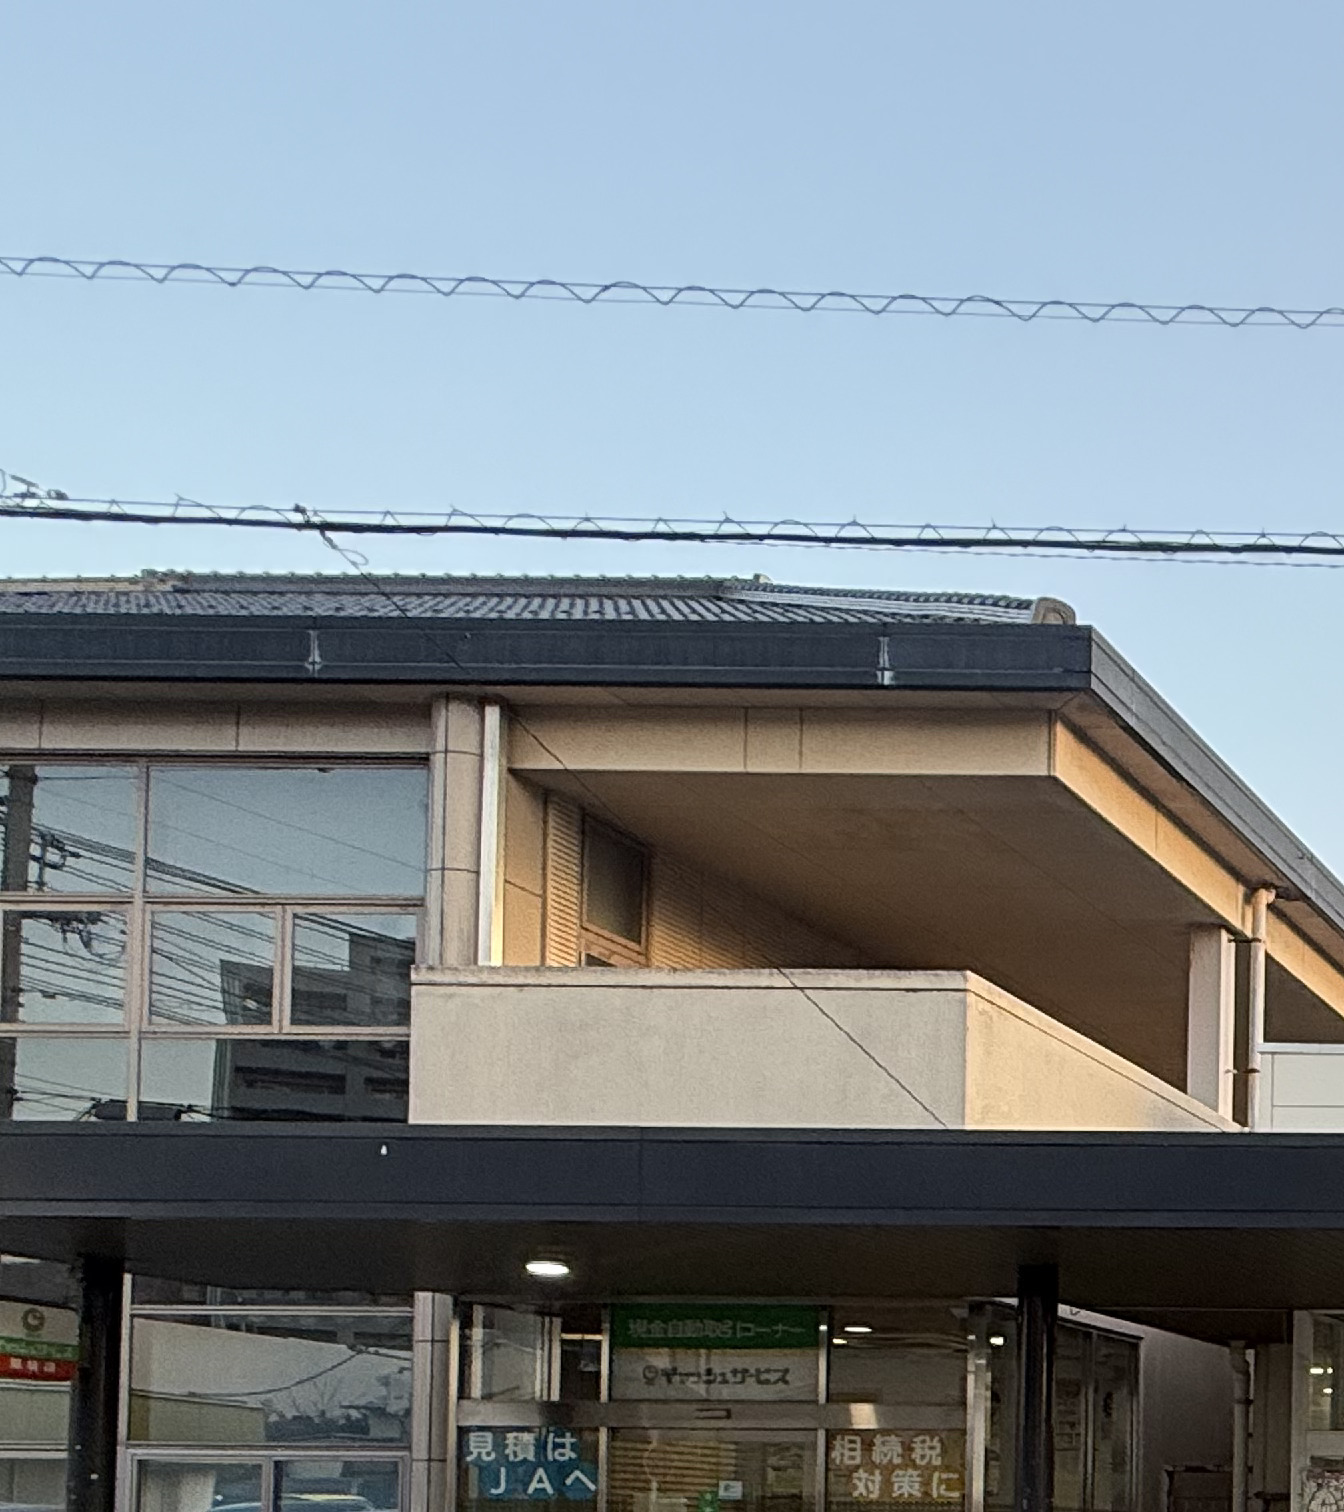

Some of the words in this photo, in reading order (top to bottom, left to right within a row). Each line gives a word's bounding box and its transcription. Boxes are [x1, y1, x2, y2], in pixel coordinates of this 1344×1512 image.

[465, 1431, 578, 1462] 見積は
[831, 1434, 943, 1466] 相続税
[852, 1468, 961, 1499] 対策に
